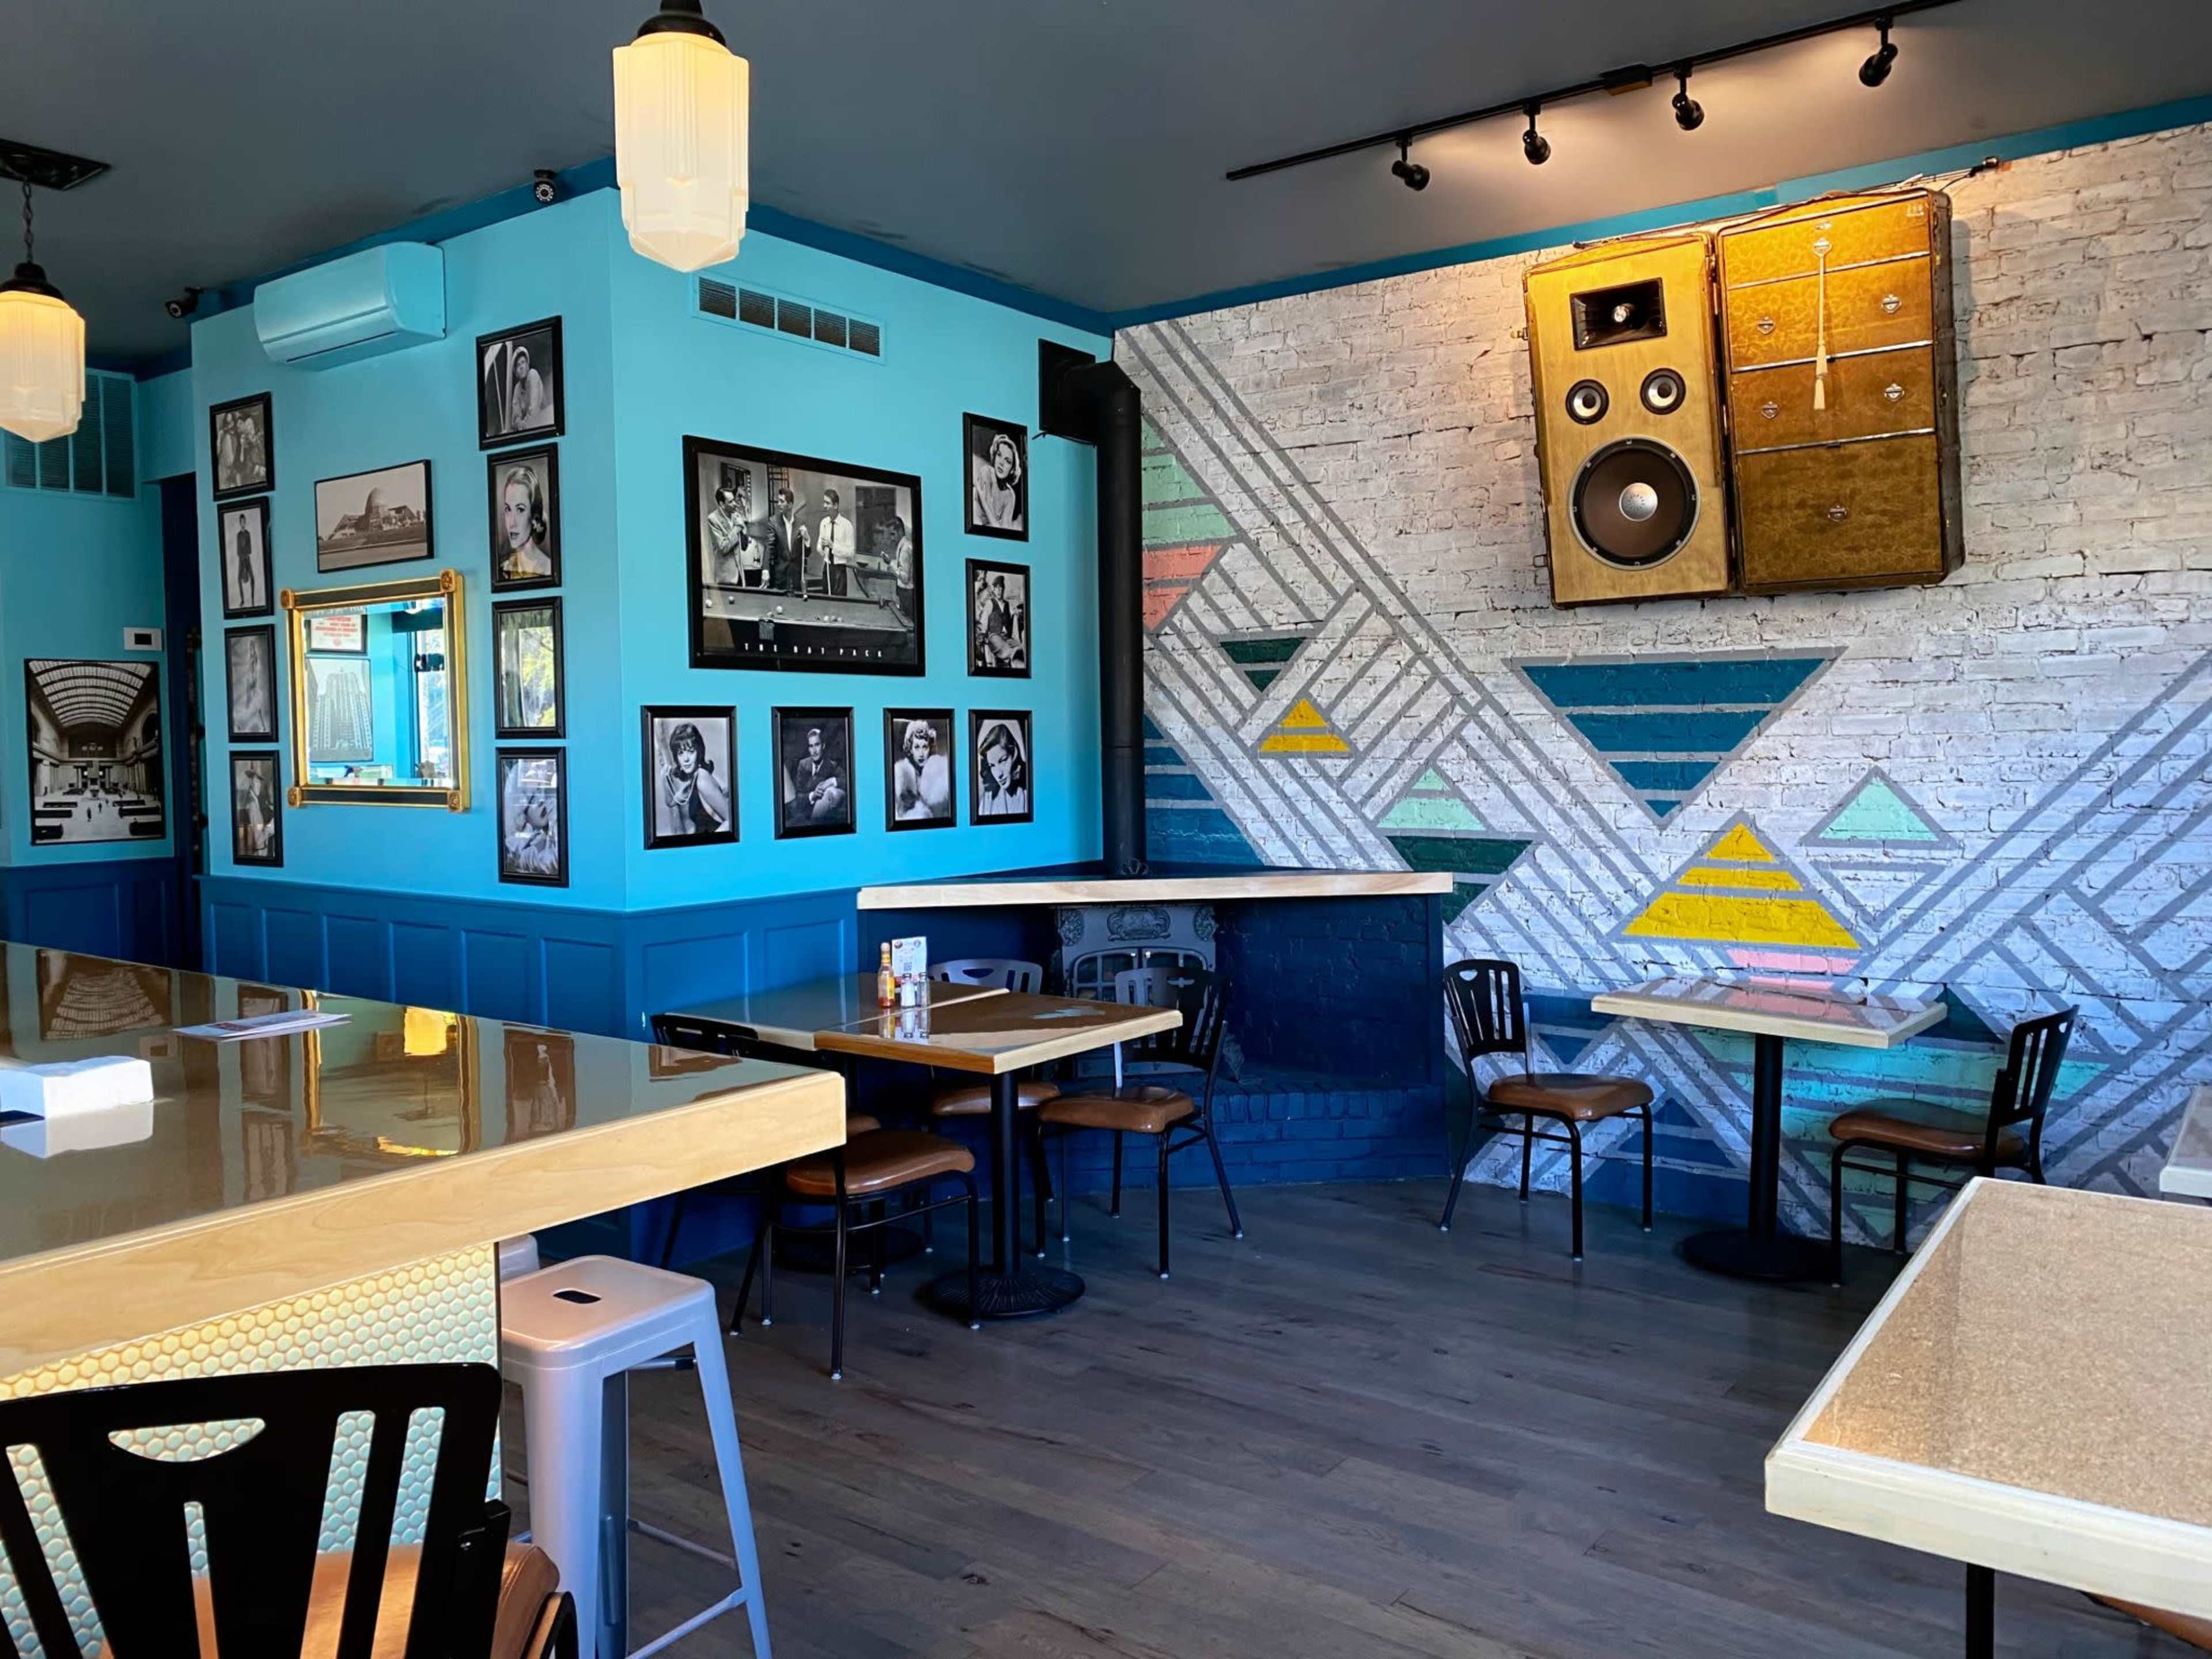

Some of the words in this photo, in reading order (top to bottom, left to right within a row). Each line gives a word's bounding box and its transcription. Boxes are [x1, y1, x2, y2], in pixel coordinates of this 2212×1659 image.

[744, 643, 778, 652] THE
[793, 645, 825, 654] RAT
[839, 648, 882, 657] PACK
